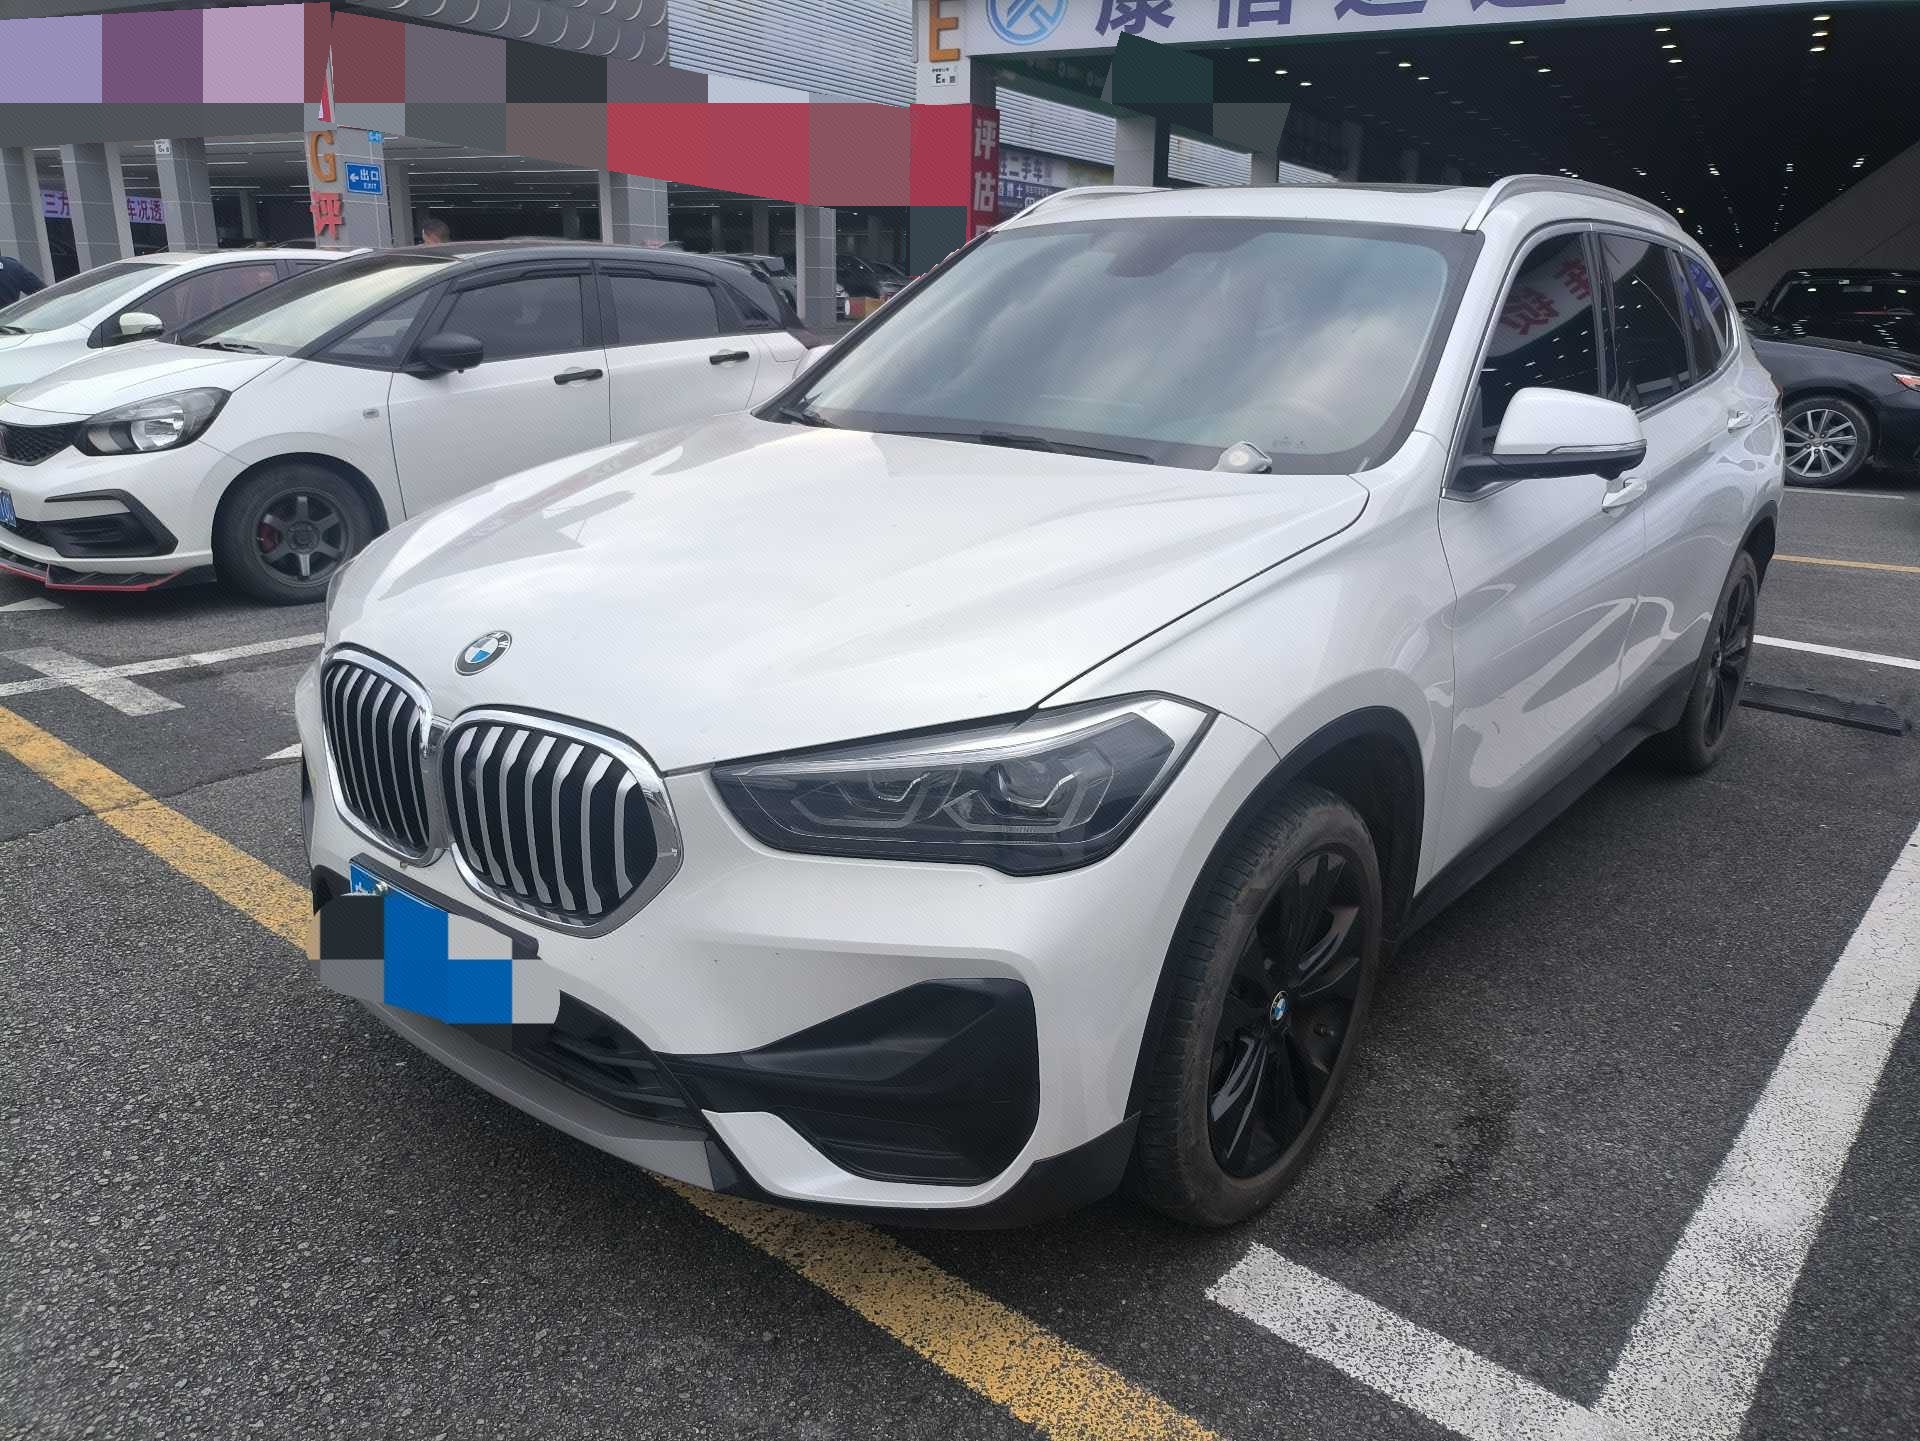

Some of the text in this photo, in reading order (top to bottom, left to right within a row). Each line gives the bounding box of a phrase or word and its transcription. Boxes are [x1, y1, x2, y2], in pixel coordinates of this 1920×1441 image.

[929, 0, 960, 63] E
[309, 130, 337, 182] G
[360, 168, 379, 181] 出口
[974, 119, 997, 236] 评估
